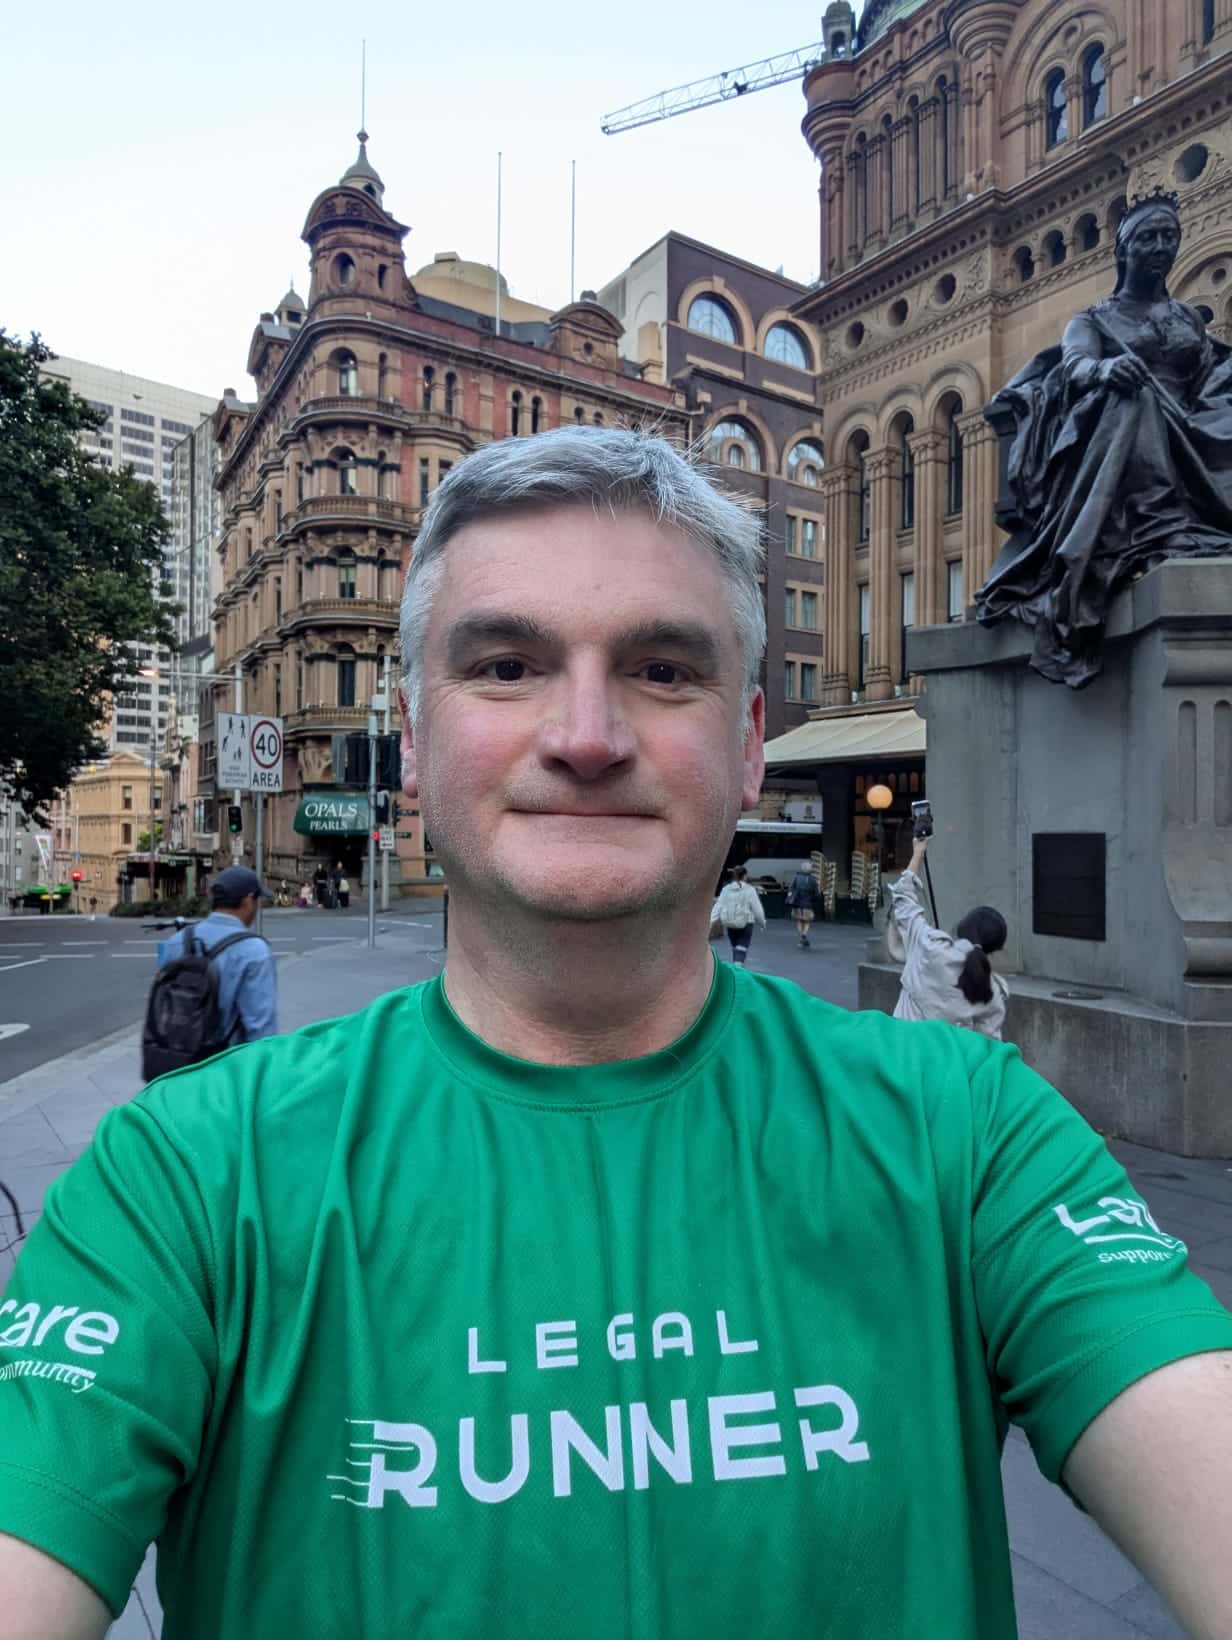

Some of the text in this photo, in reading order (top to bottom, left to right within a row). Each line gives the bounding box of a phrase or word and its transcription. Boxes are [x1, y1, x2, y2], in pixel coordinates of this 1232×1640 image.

[256, 734, 278, 757] 40
[252, 772, 281, 787] AREA
[304, 802, 358, 818] OPALS
[309, 820, 349, 831] PEARLS
[467, 1310, 758, 1374] LEGAL
[364, 1384, 870, 1508] RUNNER
